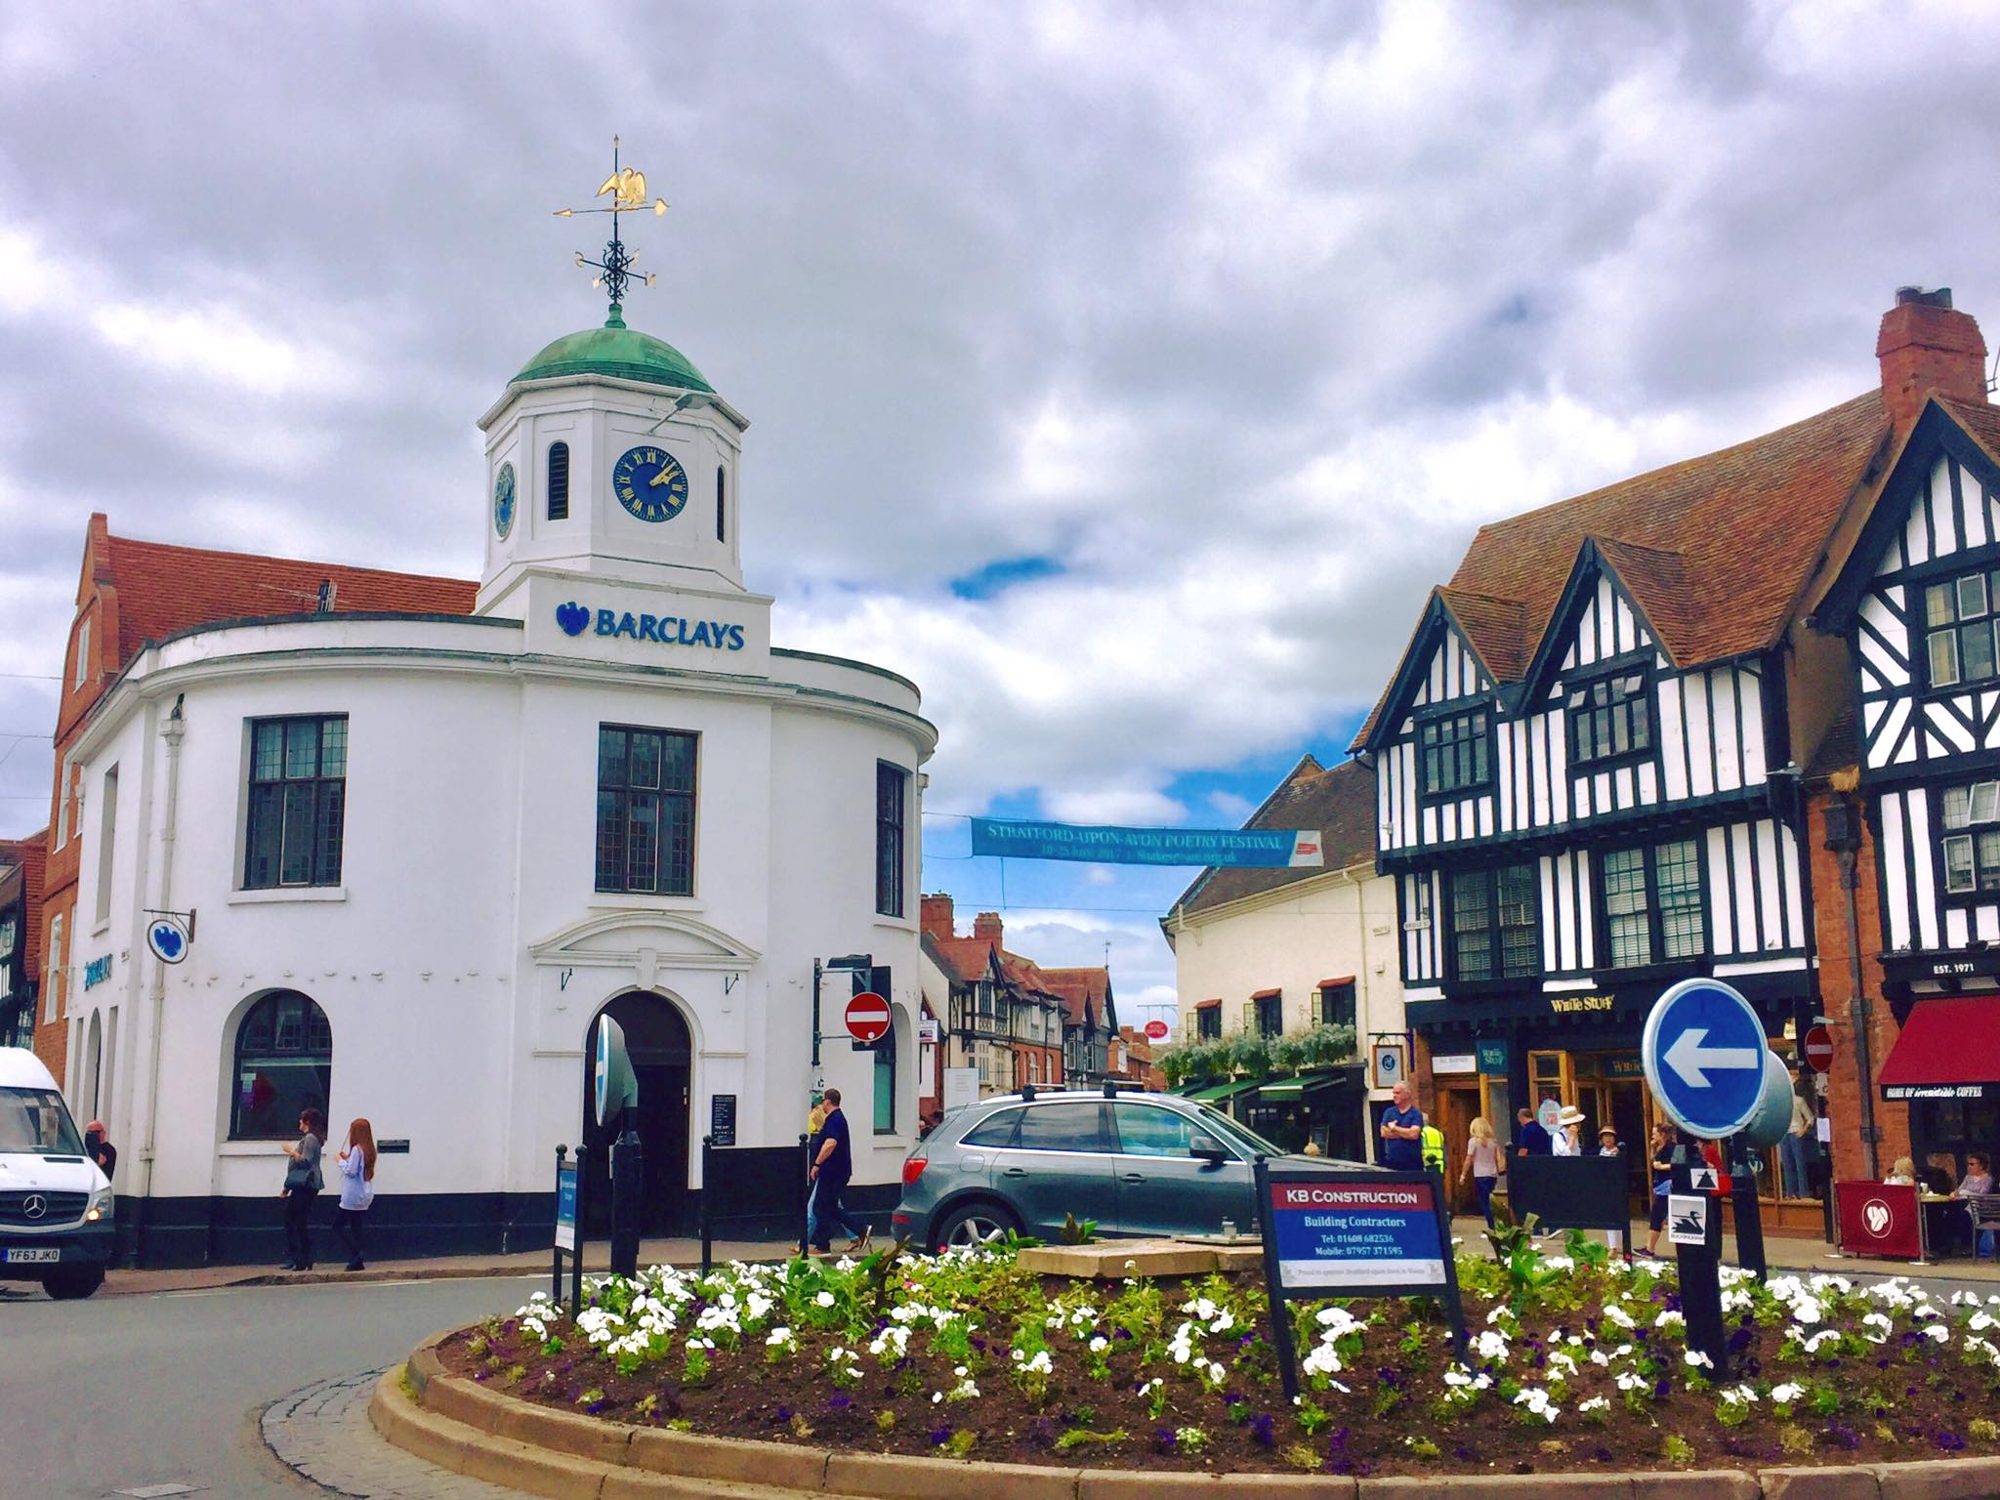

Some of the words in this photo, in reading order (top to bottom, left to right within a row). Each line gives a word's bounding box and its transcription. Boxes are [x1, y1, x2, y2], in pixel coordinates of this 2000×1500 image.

[596, 608, 745, 651] BARCLAYS
[1165, 833, 1218, 848] POETRY
[1221, 836, 1283, 850] FESTIVAL
[1933, 964, 1952, 975] EST.
[1954, 963, 1975, 973] 1971
[1286, 1190, 1309, 1203] KB
[1312, 1190, 1417, 1204] CONSTRUCTION
[1304, 1216, 1347, 1229] Building
[1349, 1217, 1407, 1228] Contractors
[1321, 1234, 1336, 1244] Tel:
[10, 1250, 37, 1261] YF63
[1315, 1247, 1344, 1257] Mobile:
